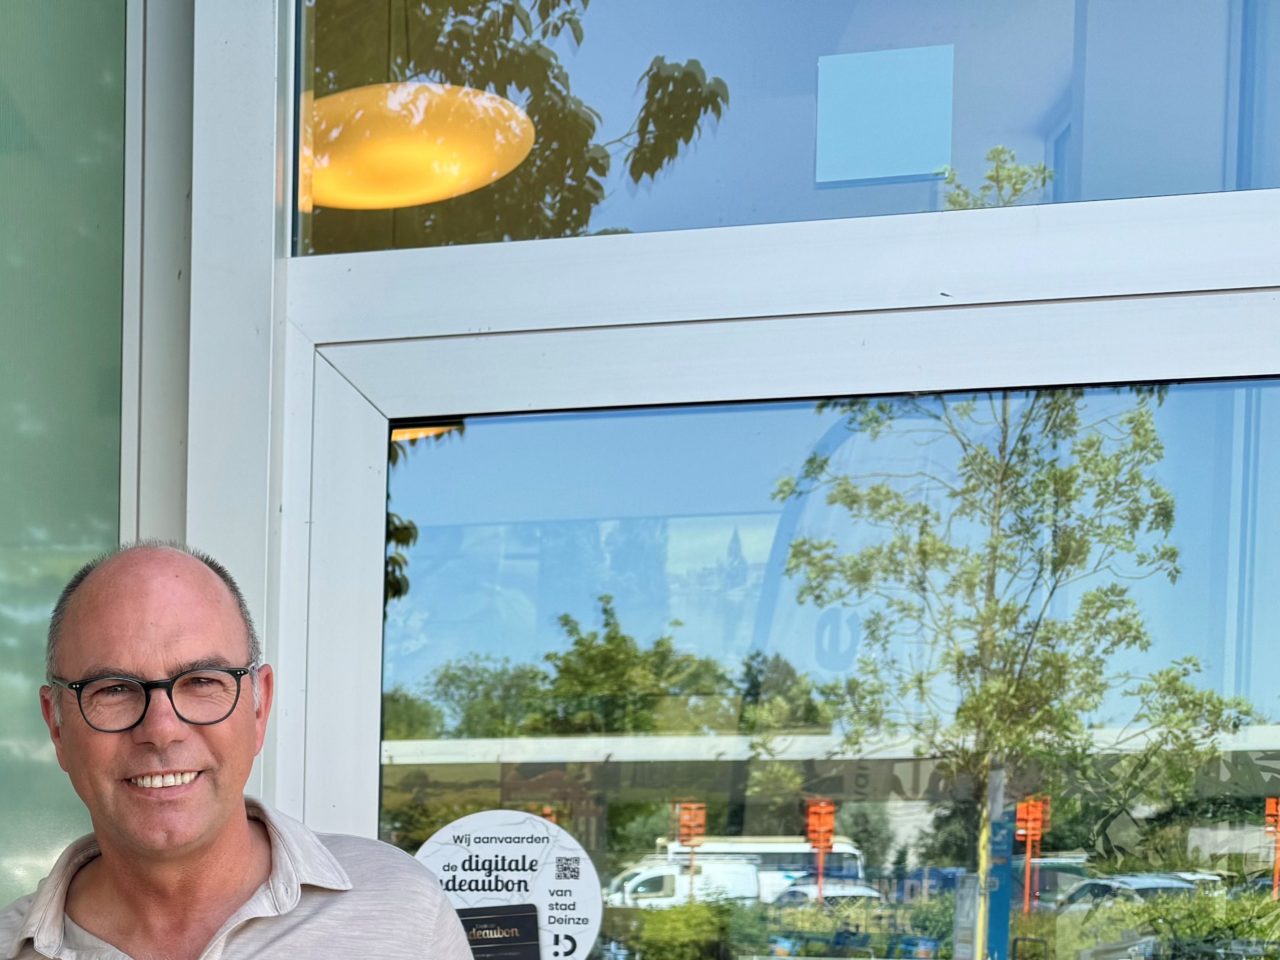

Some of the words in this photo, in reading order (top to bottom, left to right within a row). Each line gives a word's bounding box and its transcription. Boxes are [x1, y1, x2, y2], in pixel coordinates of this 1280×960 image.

[452, 833, 471, 847] Wij
[473, 833, 550, 845] aanvaarden
[442, 861, 458, 872] de
[461, 854, 539, 878] digitale
[439, 874, 530, 893] deaubon
[548, 888, 572, 898] van
[548, 901, 576, 912] stad
[547, 915, 589, 926] Deinze
[467, 926, 520, 940] deaubon
